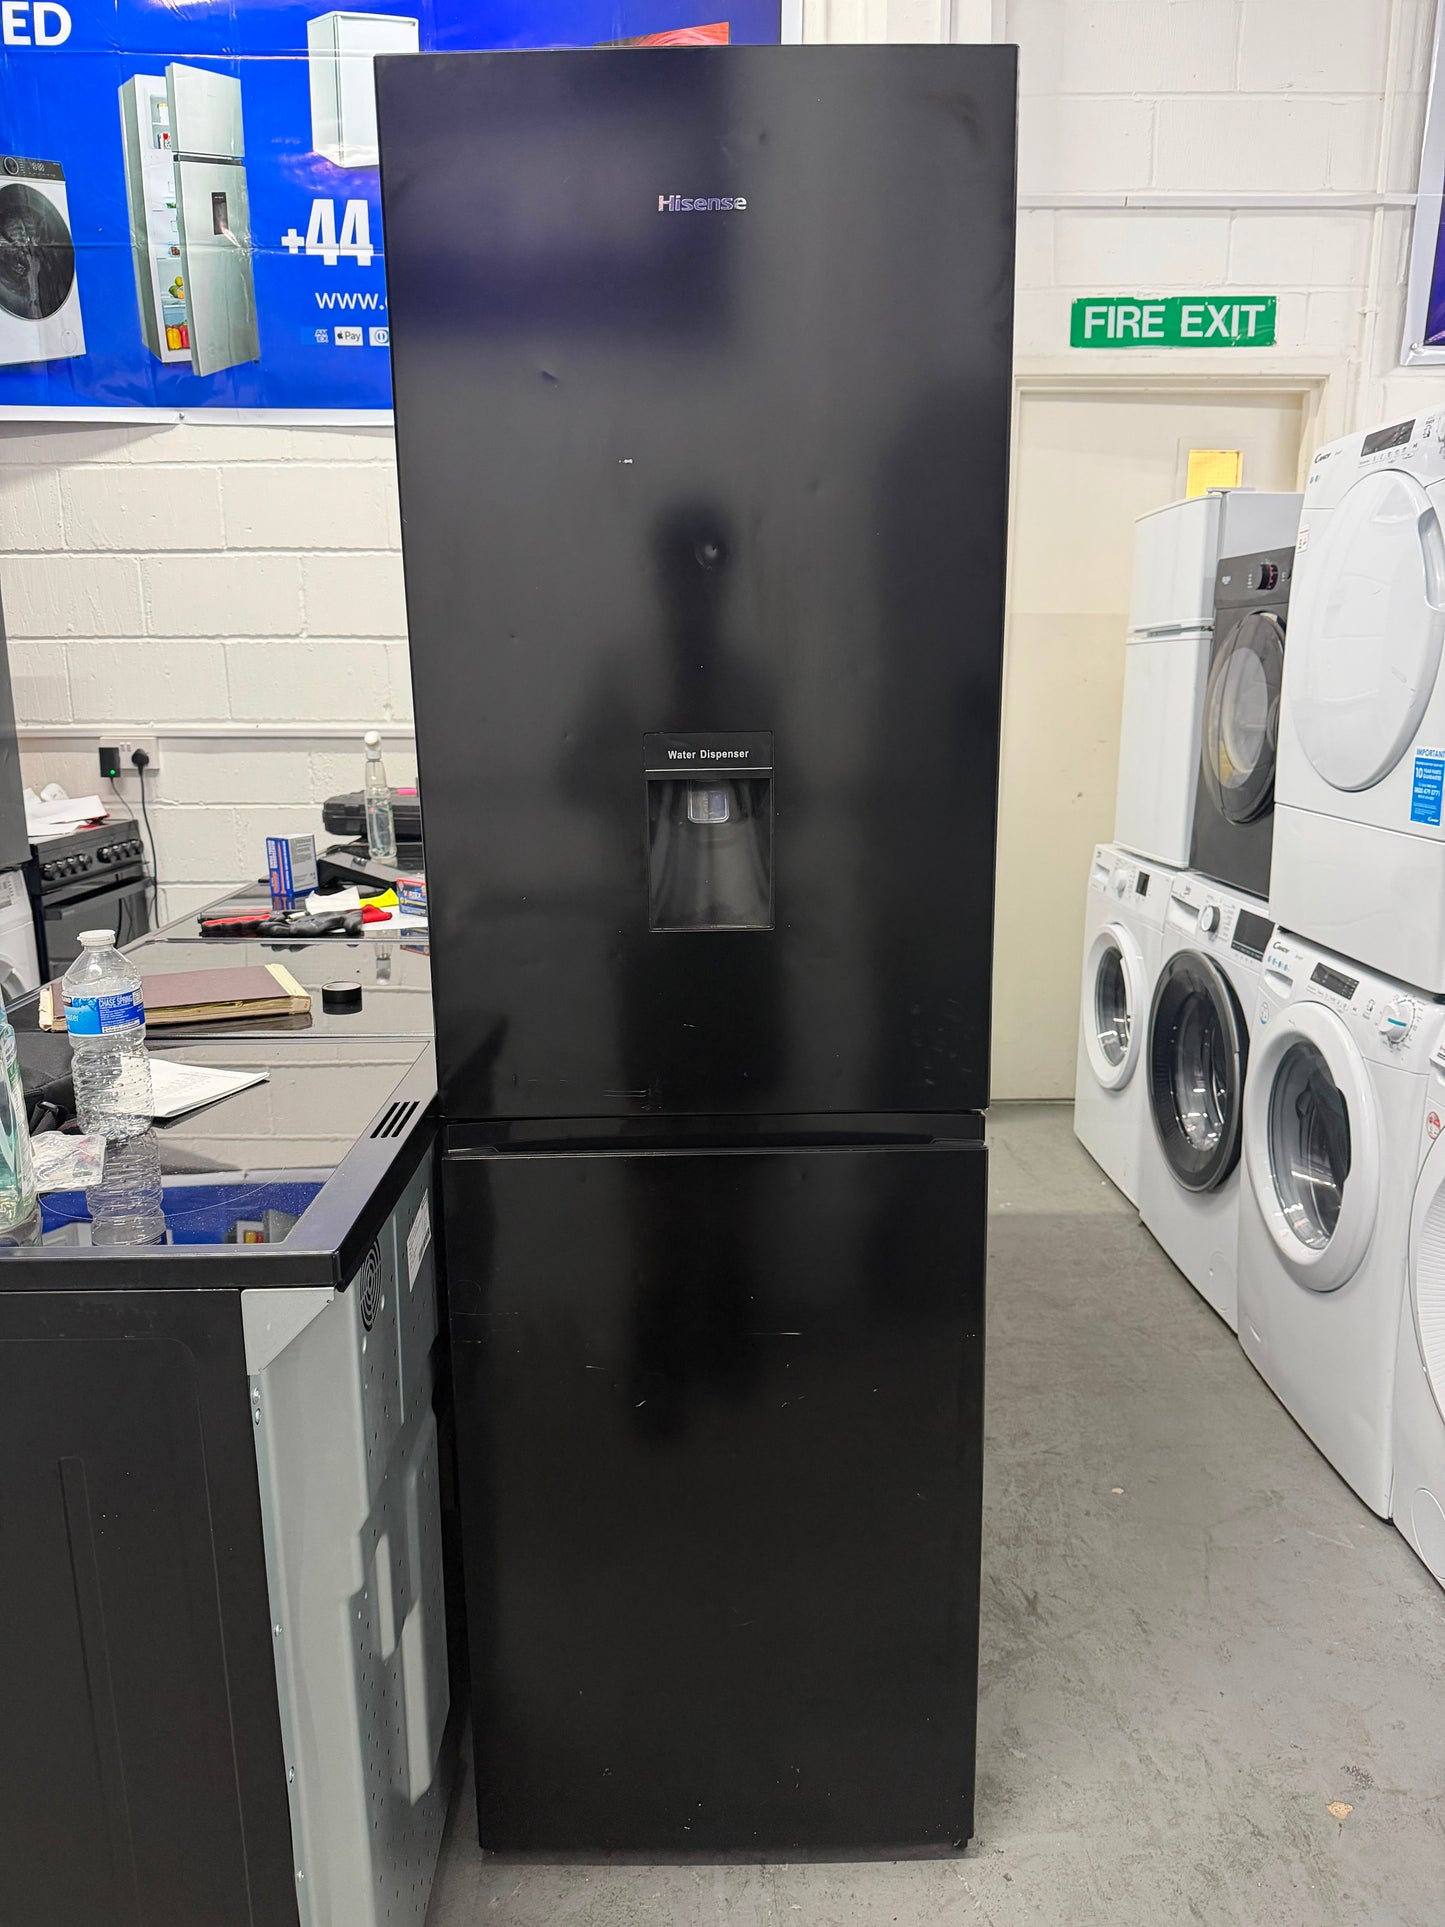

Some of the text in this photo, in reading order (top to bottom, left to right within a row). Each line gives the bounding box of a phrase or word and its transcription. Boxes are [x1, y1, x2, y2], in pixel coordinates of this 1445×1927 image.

[2, 1, 72, 46] ED
[658, 195, 747, 211] Hisense
[281, 199, 374, 266] +44
[315, 292, 388, 310] www.
[1084, 305, 1266, 339] FIRE EXIT
[345, 331, 361, 342] Pay
[667, 749, 749, 760] Water Dispenser
[1415, 767, 1423, 779] 10
